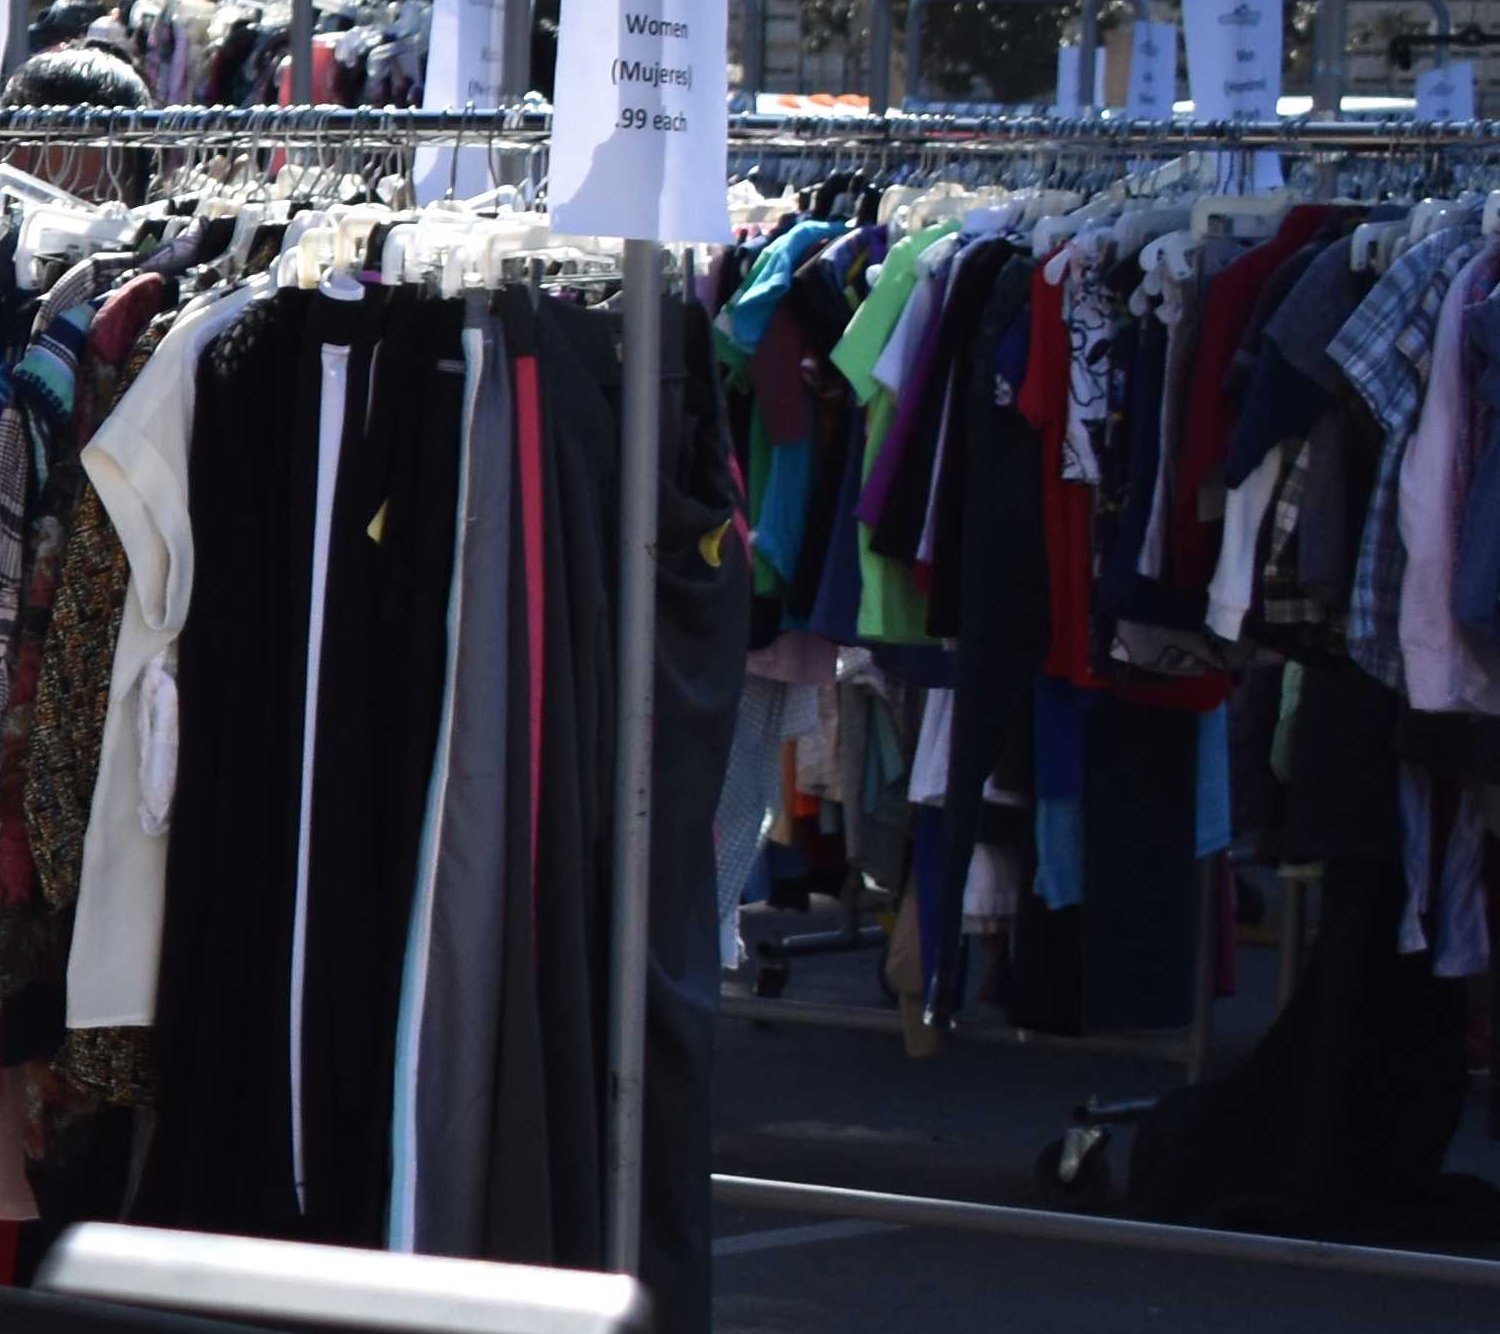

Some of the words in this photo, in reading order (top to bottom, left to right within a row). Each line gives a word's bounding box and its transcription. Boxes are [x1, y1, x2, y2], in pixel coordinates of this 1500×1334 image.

[625, 12, 689, 39] Women
[611, 58, 693, 91] (Mujeres)
[614, 107, 648, 130] .99
[652, 110, 688, 132] each
